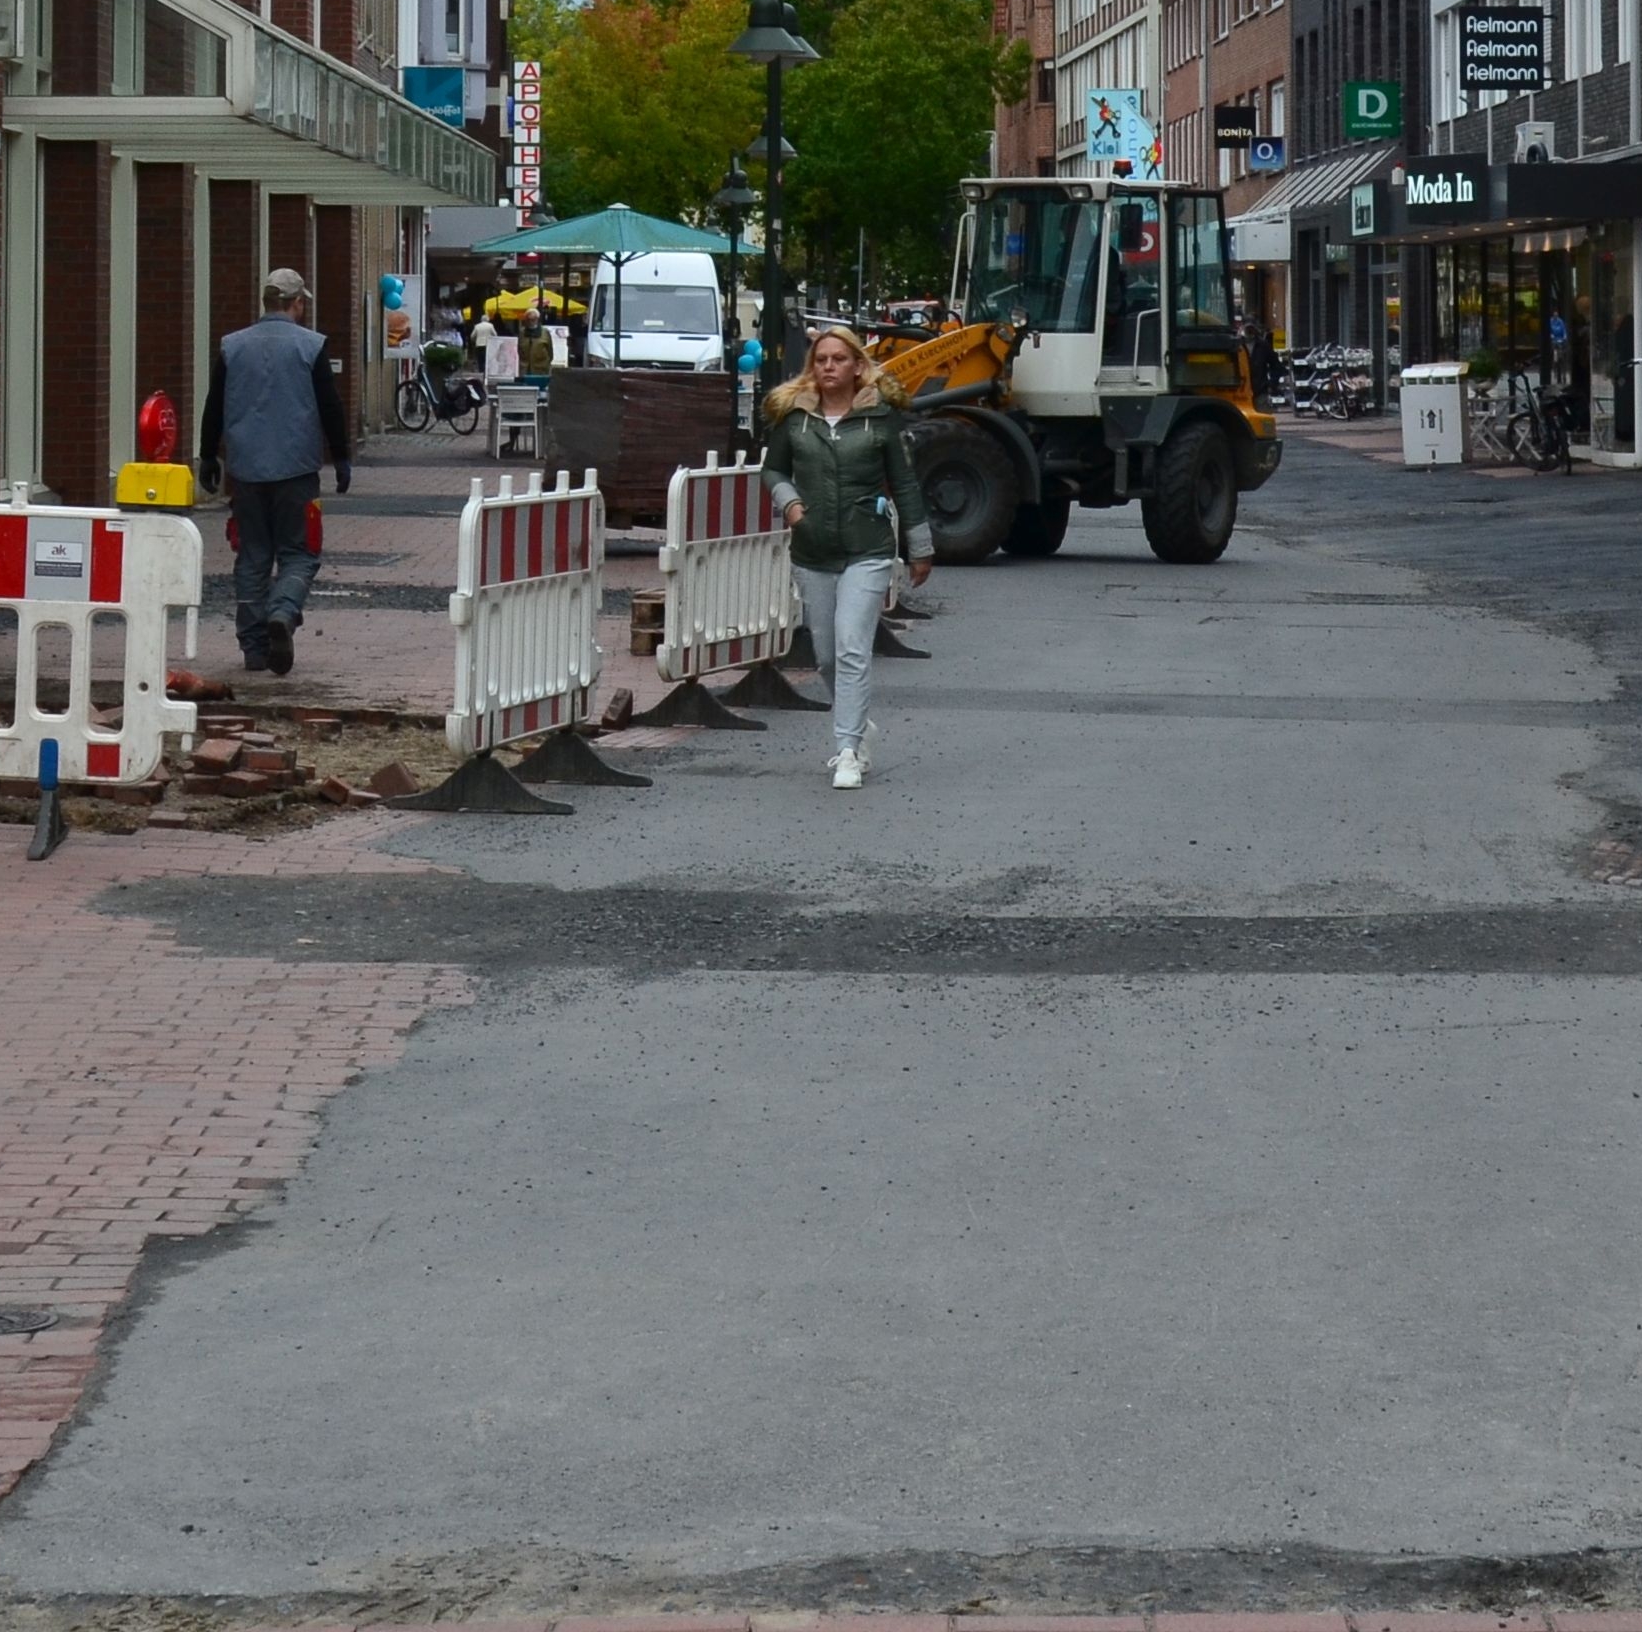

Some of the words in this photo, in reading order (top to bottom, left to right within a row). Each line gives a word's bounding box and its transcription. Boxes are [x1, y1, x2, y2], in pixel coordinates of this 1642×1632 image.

[1358, 89, 1388, 119] D
[1406, 173, 1453, 205] Moda
[1455, 172, 1474, 202] In
